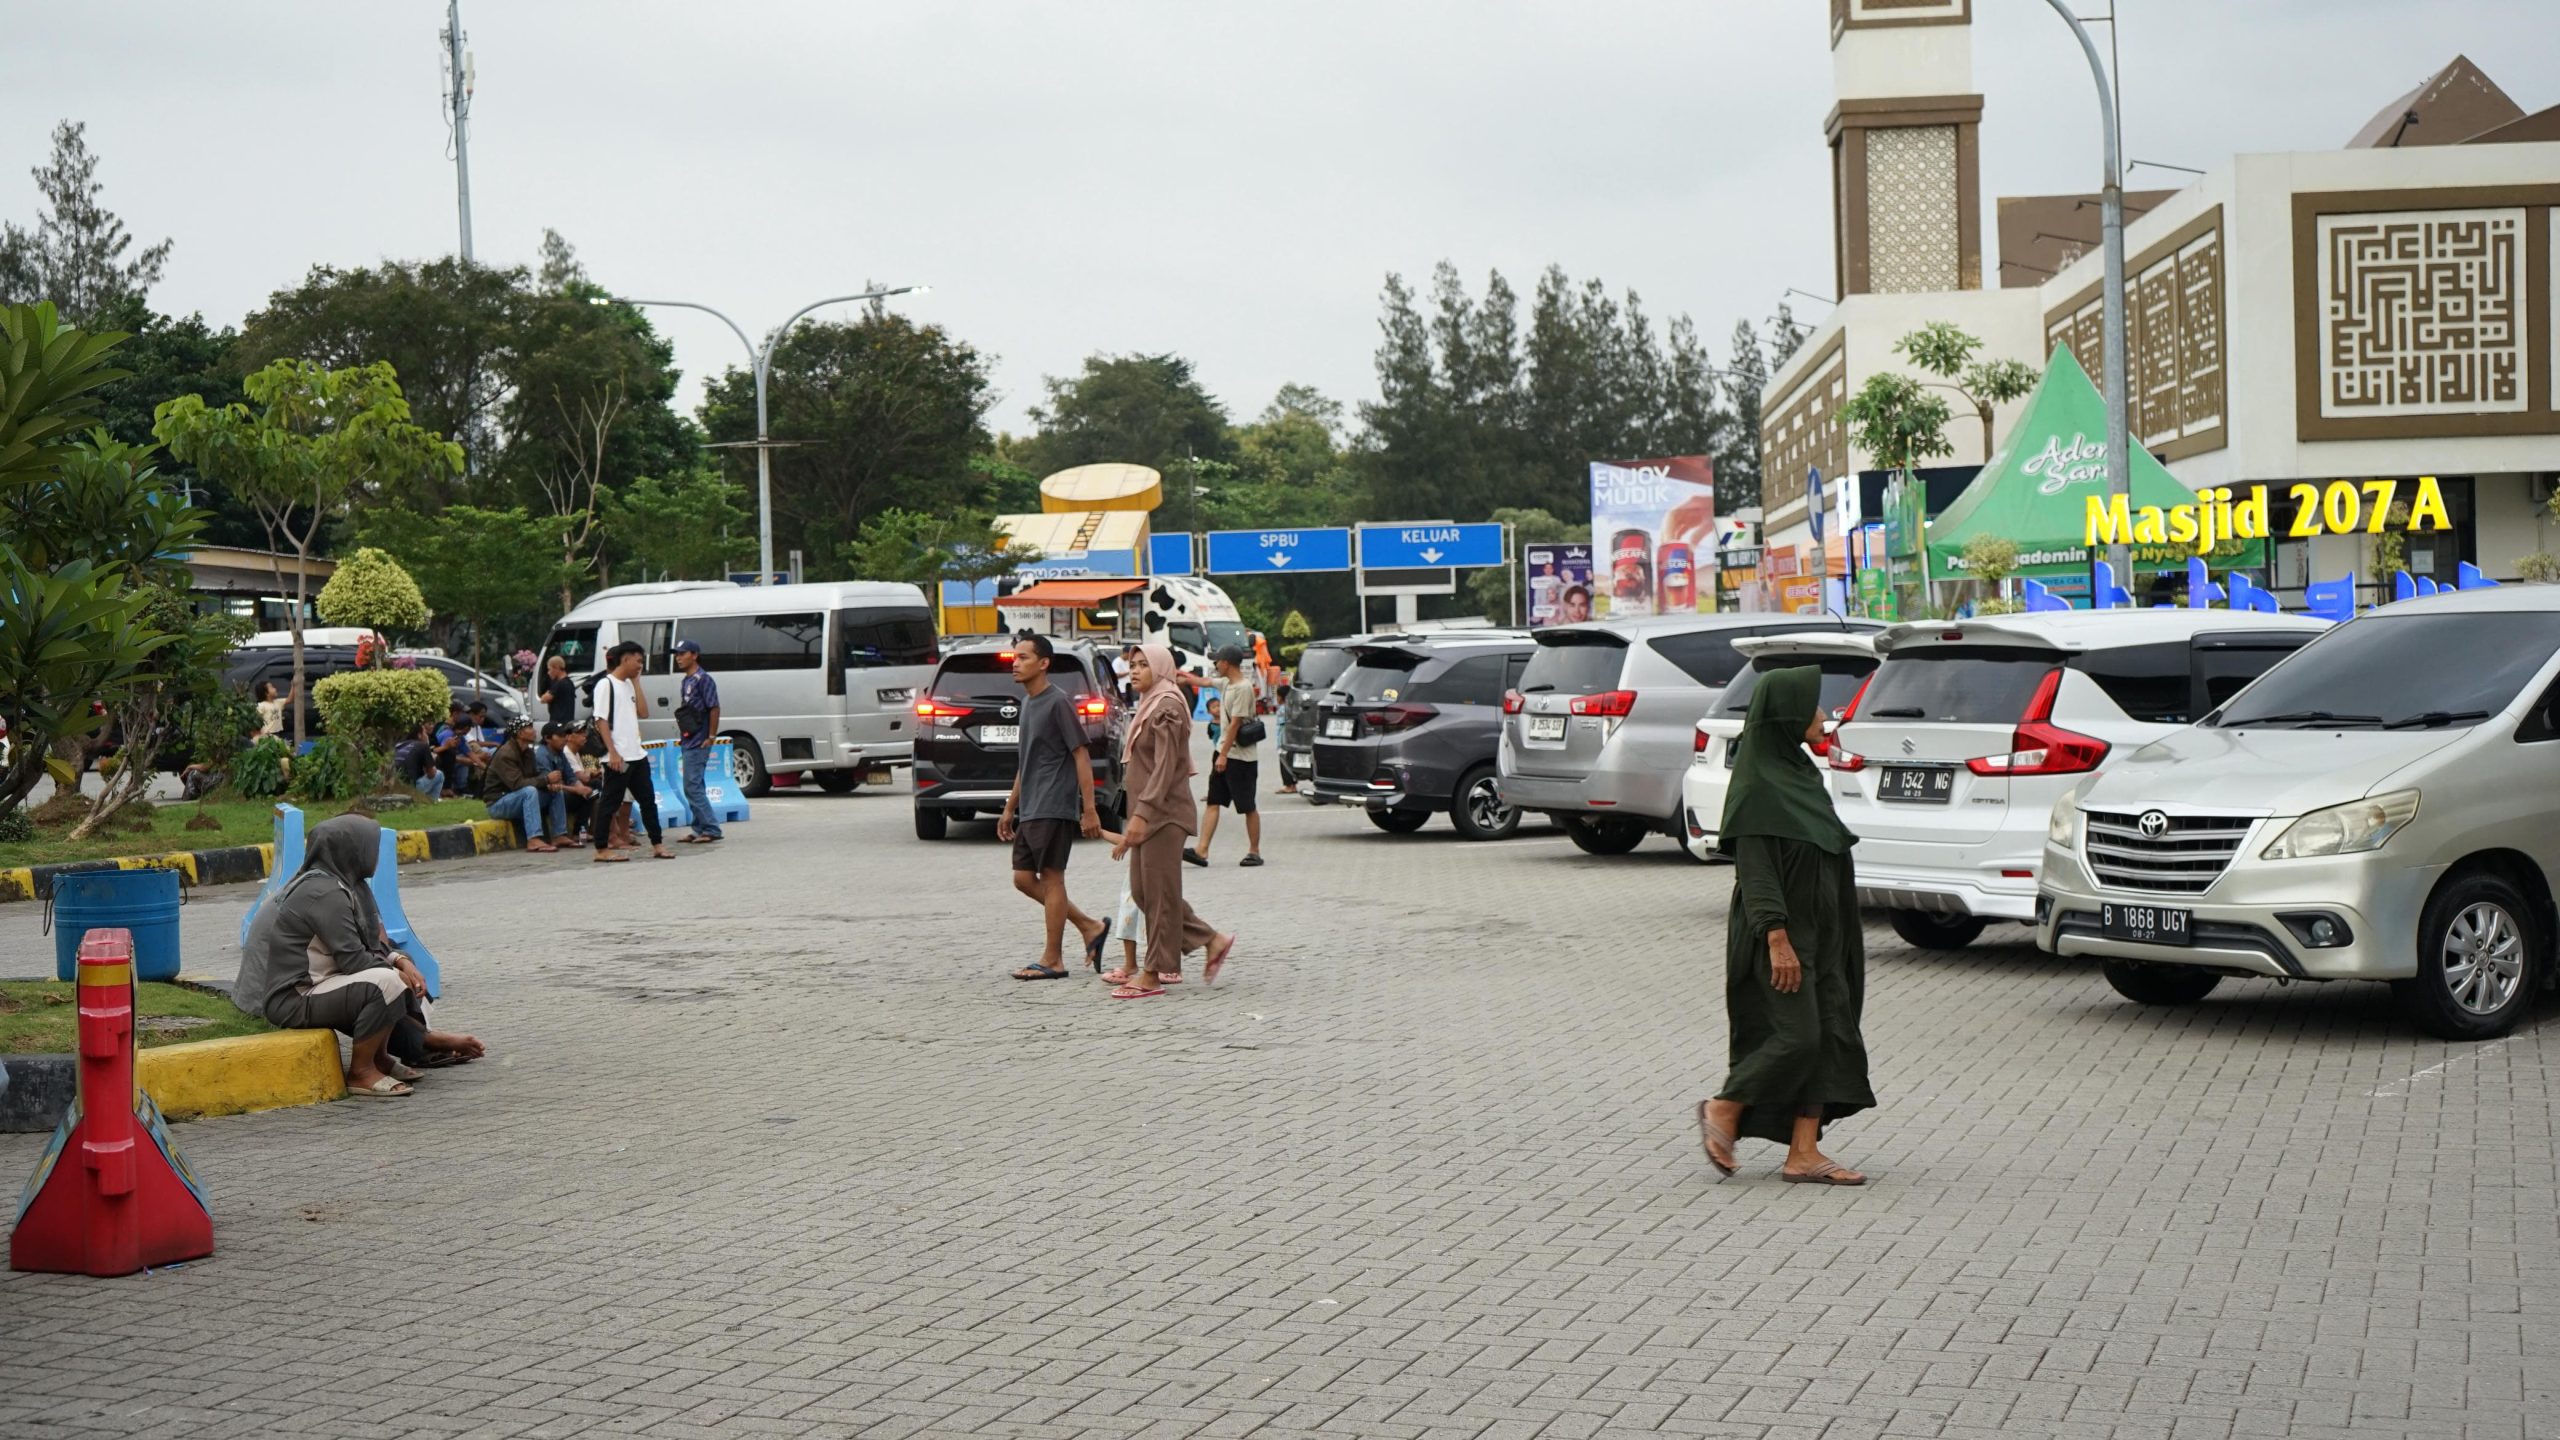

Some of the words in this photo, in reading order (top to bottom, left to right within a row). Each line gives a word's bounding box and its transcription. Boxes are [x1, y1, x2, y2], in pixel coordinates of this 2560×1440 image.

[1594, 465, 1670, 488] ENJOY
[1594, 486, 1669, 507] MUDIK
[2085, 485, 2270, 555] Masjid
[2288, 480, 2397, 538] 207
[2406, 476, 2453, 531] A
[1260, 533, 1299, 548] SPBU
[1401, 528, 1461, 543] KELUAR
[982, 726, 988, 737] E
[995, 726, 1018, 737] 1288
[1882, 771, 1891, 789] H
[1901, 771, 1926, 790] 1542
[1934, 772, 1949, 790] NG
[2104, 904, 2113, 926] B
[2123, 906, 2154, 930] 1868
[2162, 909, 2187, 933] UGY
